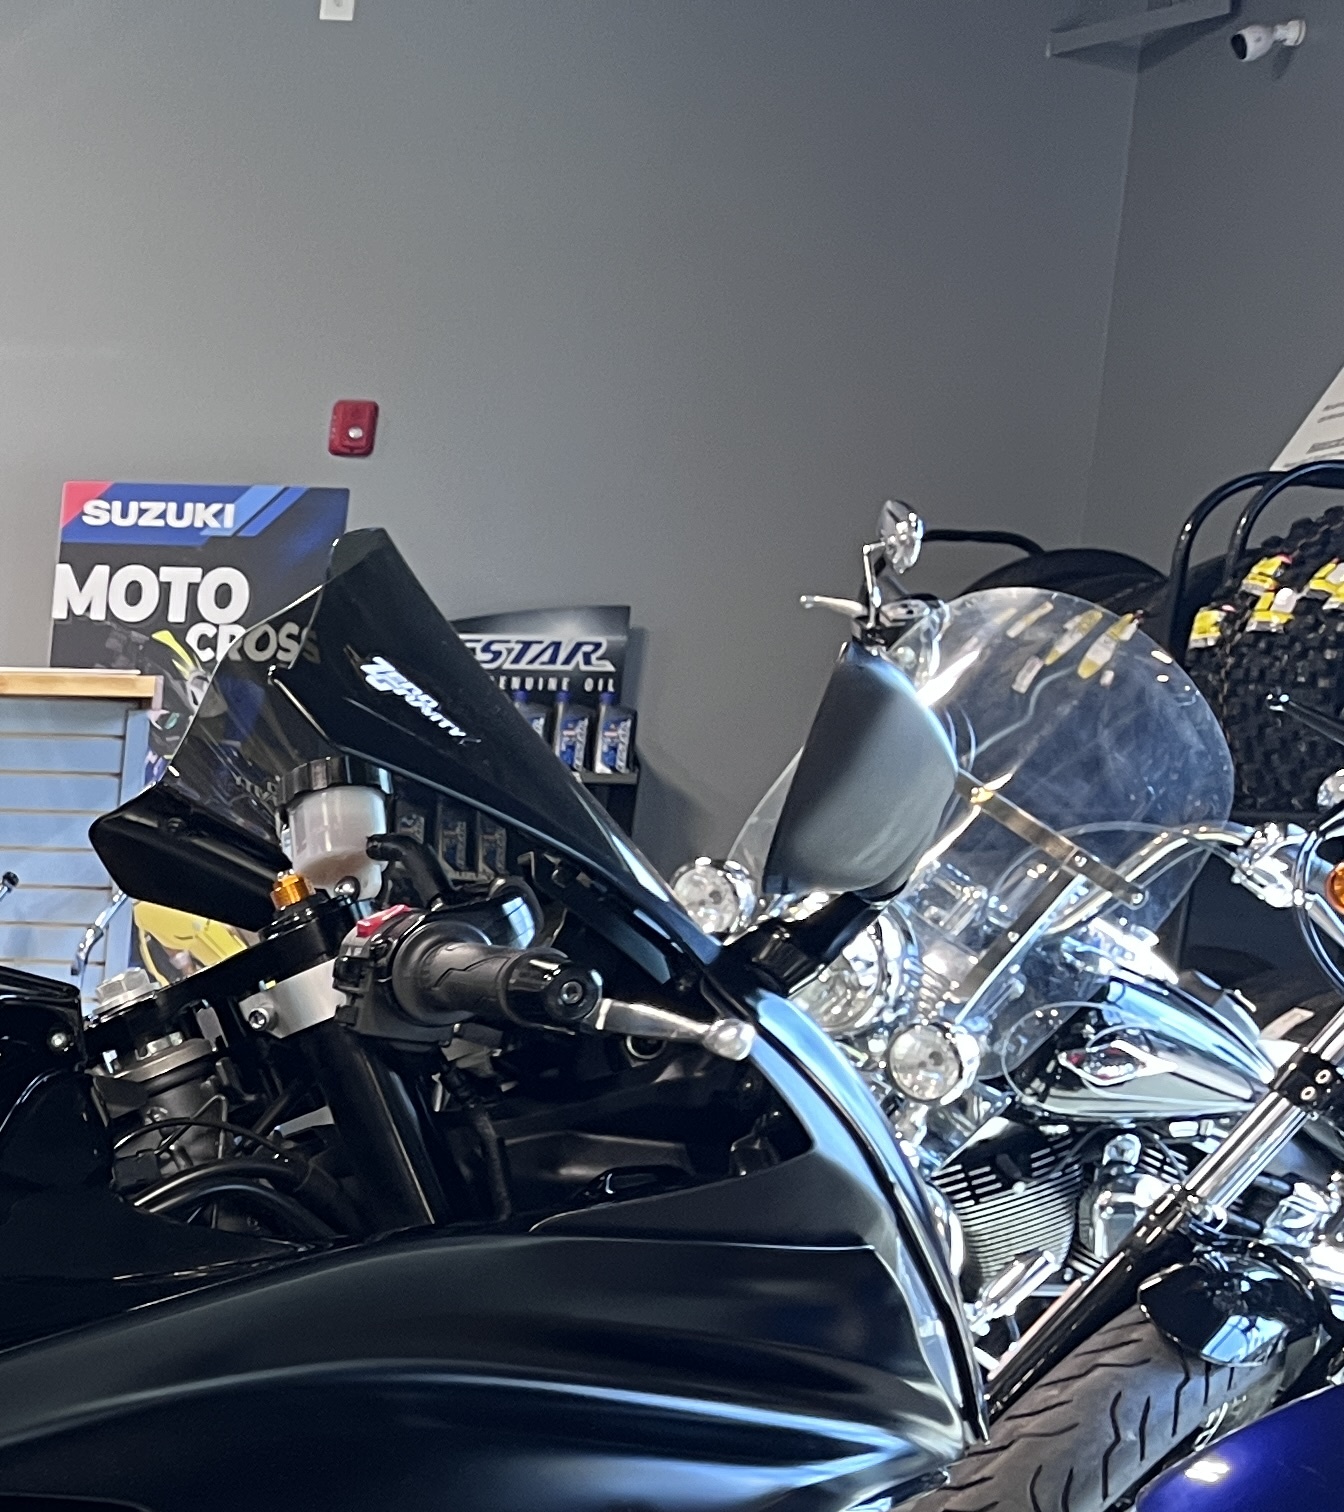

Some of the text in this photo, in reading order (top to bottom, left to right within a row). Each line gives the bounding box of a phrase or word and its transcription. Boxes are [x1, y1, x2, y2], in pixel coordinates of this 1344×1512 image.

[81, 499, 235, 529] SUZUKI
[51, 563, 250, 625] MOTO
[491, 676, 570, 691] ENUINE
